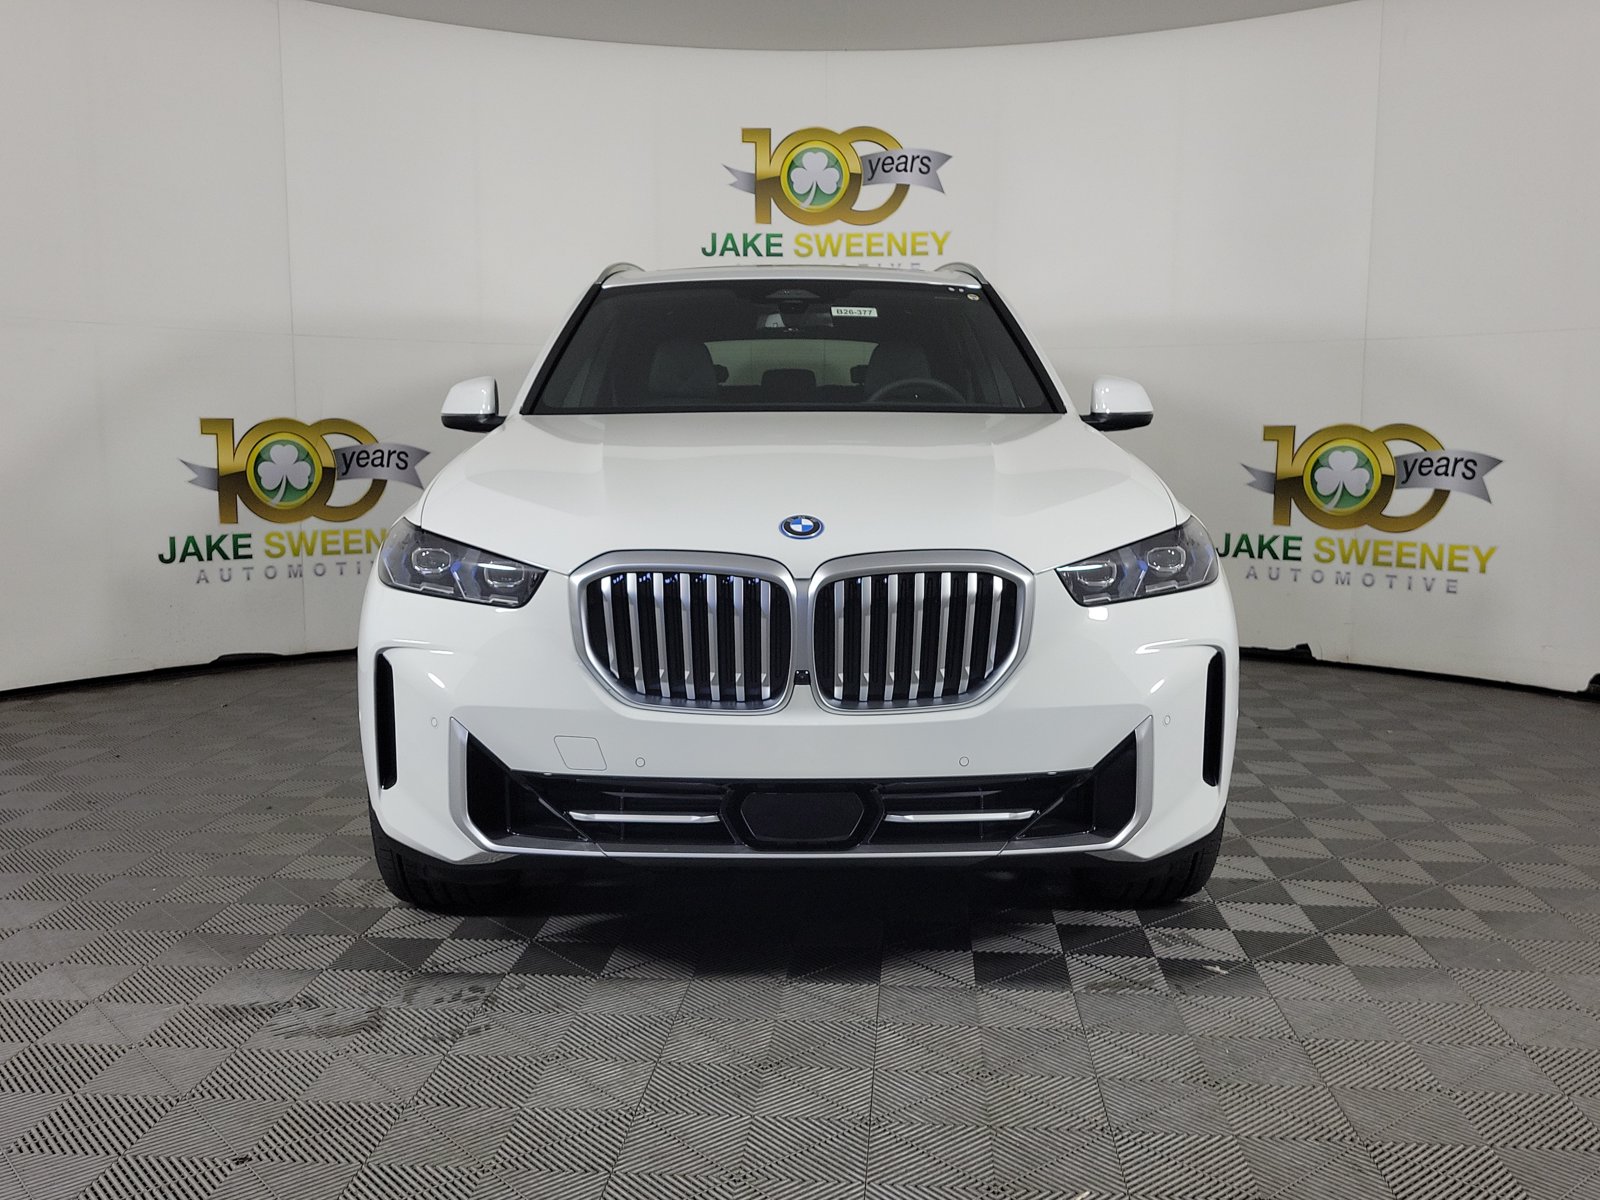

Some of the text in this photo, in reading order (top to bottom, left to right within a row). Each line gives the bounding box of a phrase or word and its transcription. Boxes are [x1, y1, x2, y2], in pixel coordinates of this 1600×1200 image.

[741, 127, 932, 226] 100 years
[701, 230, 951, 258] JAKE SWEENEY
[200, 417, 409, 524] 100 years
[1263, 423, 1478, 533] 100 years
[158, 528, 390, 564] JAKE SWEEN
[1216, 533, 1497, 574] JAKE SWEENEY
[196, 561, 375, 585] AUTOMOTI
[1245, 566, 1458, 594] AUTOMOTIVE
